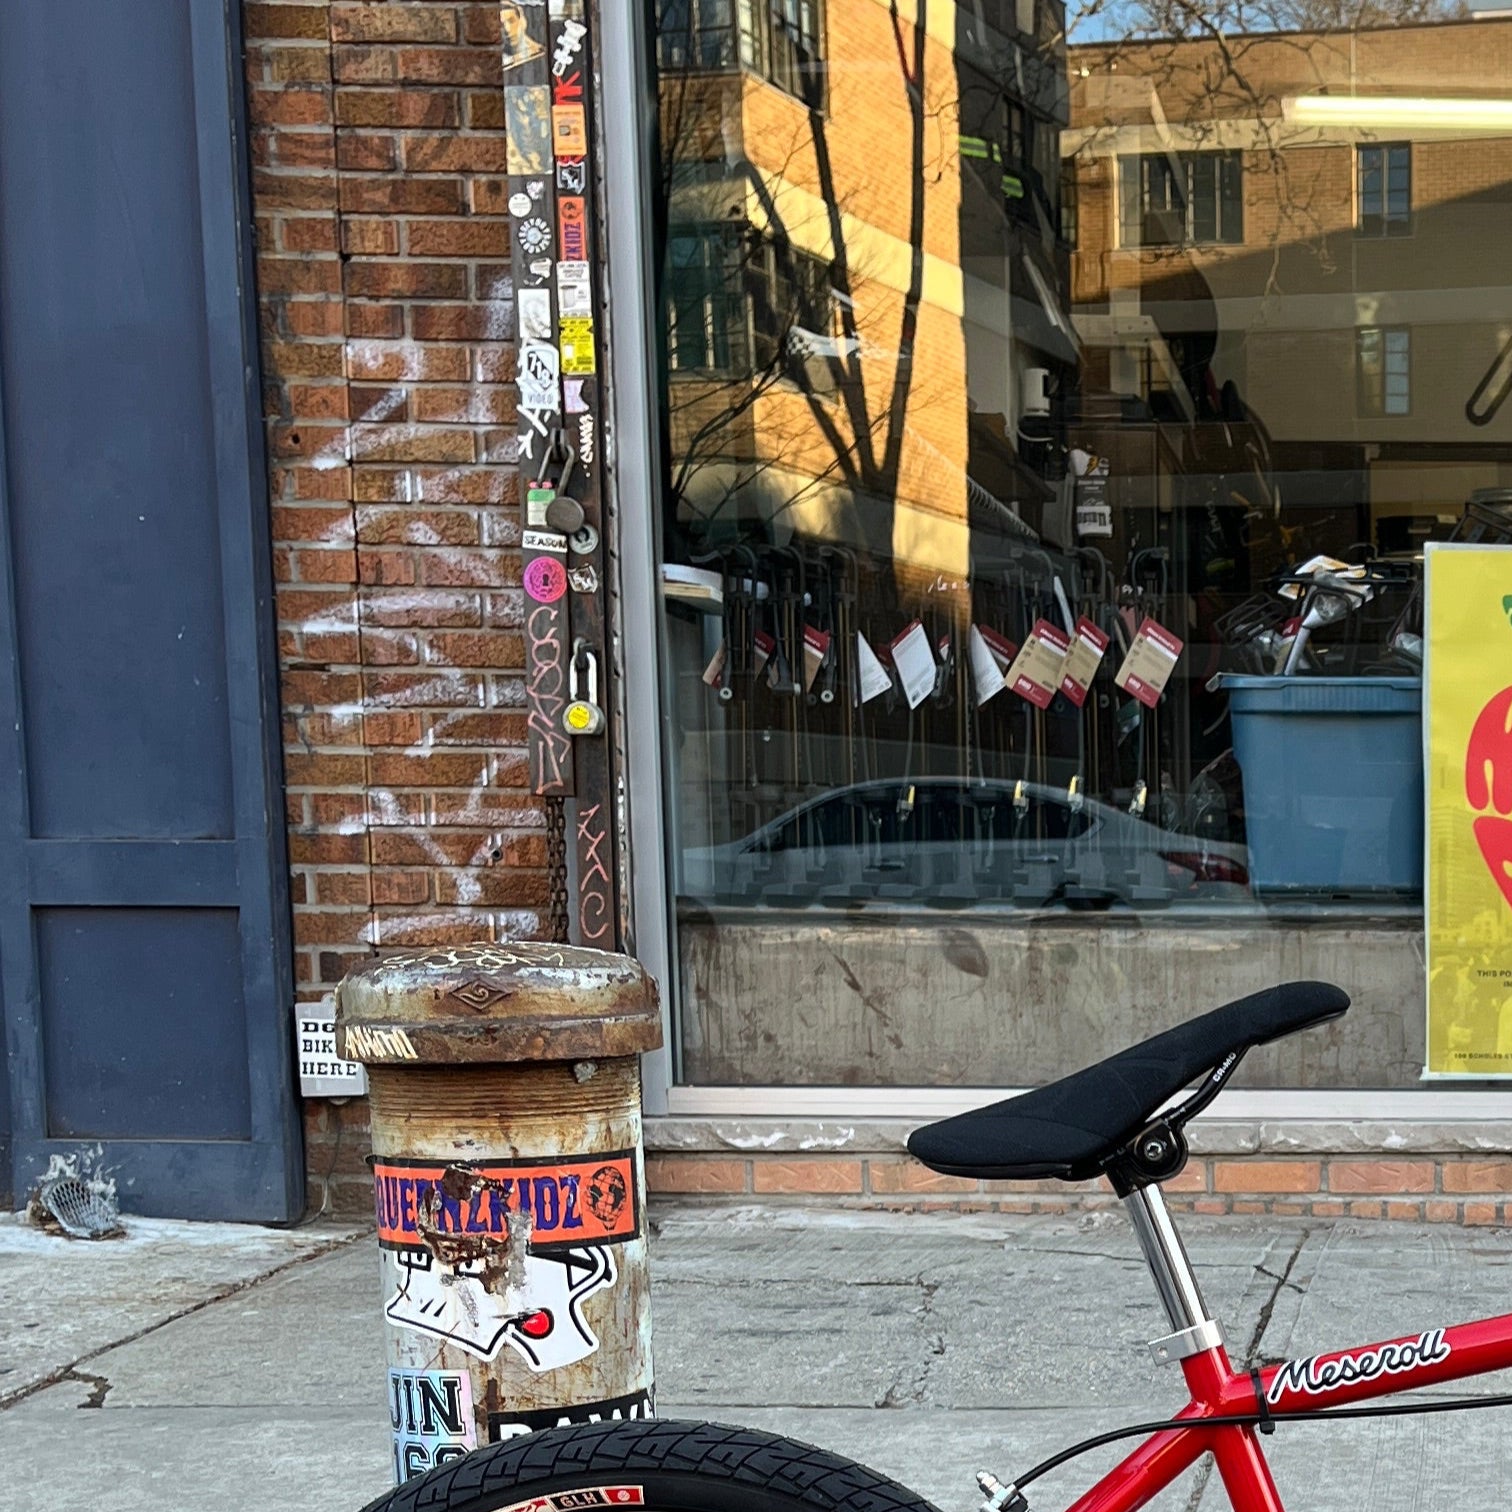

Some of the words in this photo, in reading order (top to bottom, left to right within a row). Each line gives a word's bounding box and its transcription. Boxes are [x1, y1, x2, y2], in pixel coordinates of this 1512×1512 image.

[527, 393, 554, 406] VIDEO
[1477, 970, 1498, 978] THIS
[302, 1039, 337, 1054] BIK
[301, 1063, 357, 1077] HERE
[1268, 1329, 1450, 1402] Meseroll
[558, 1491, 602, 1508] GLH
